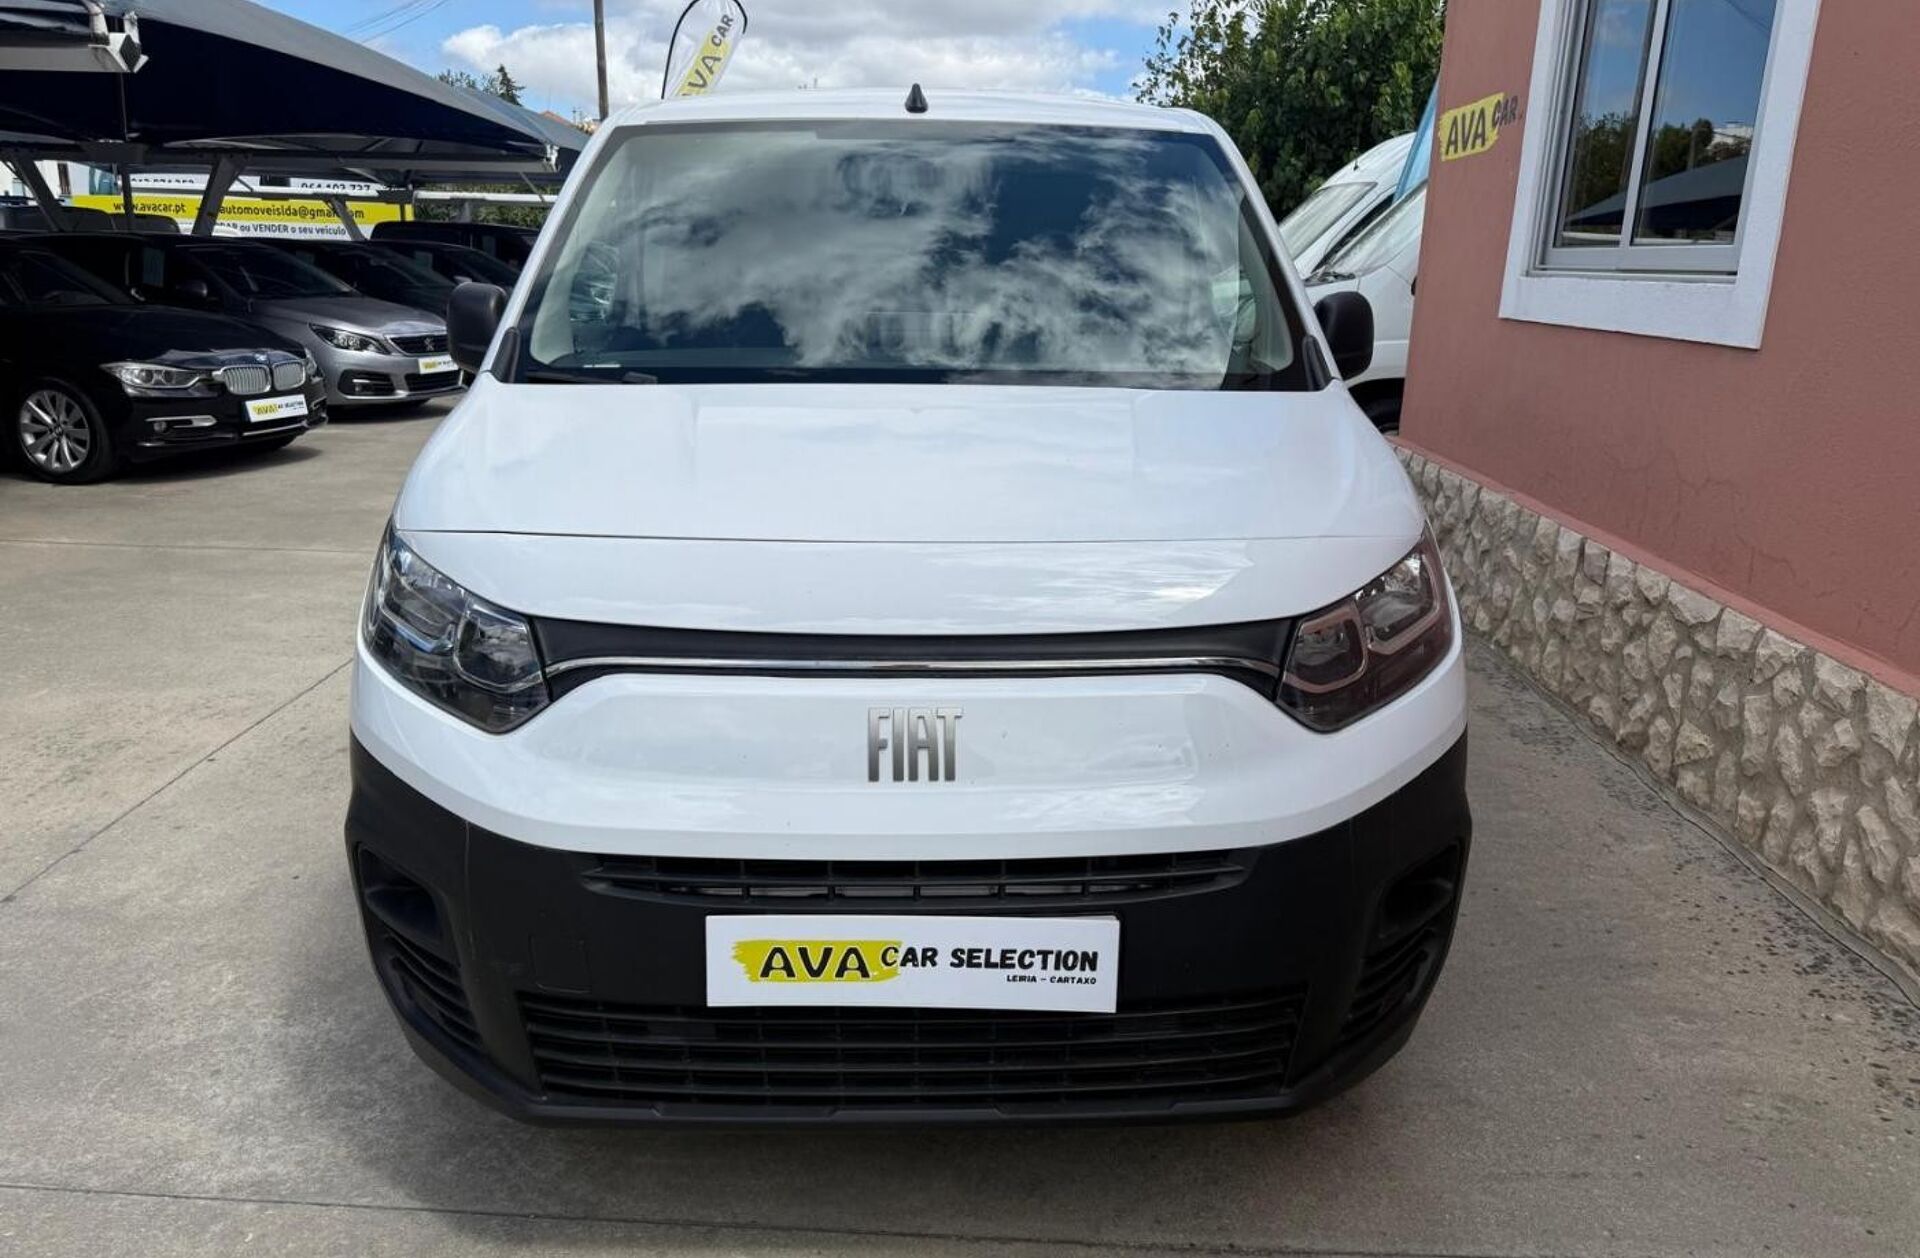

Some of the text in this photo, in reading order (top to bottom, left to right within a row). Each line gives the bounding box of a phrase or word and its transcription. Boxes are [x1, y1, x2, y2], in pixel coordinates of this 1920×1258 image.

[682, 14, 734, 96] VA CAR
[1445, 95, 1518, 155] AVA CAR
[114, 203, 186, 214] ww.avacar.pt
[252, 224, 288, 233] VENDER
[868, 706, 963, 782] FIAT
[759, 946, 1099, 979] AVA CAR SELECTION
[1006, 975, 1037, 983] LEIRIA
[1049, 976, 1097, 985] CARTAXO
